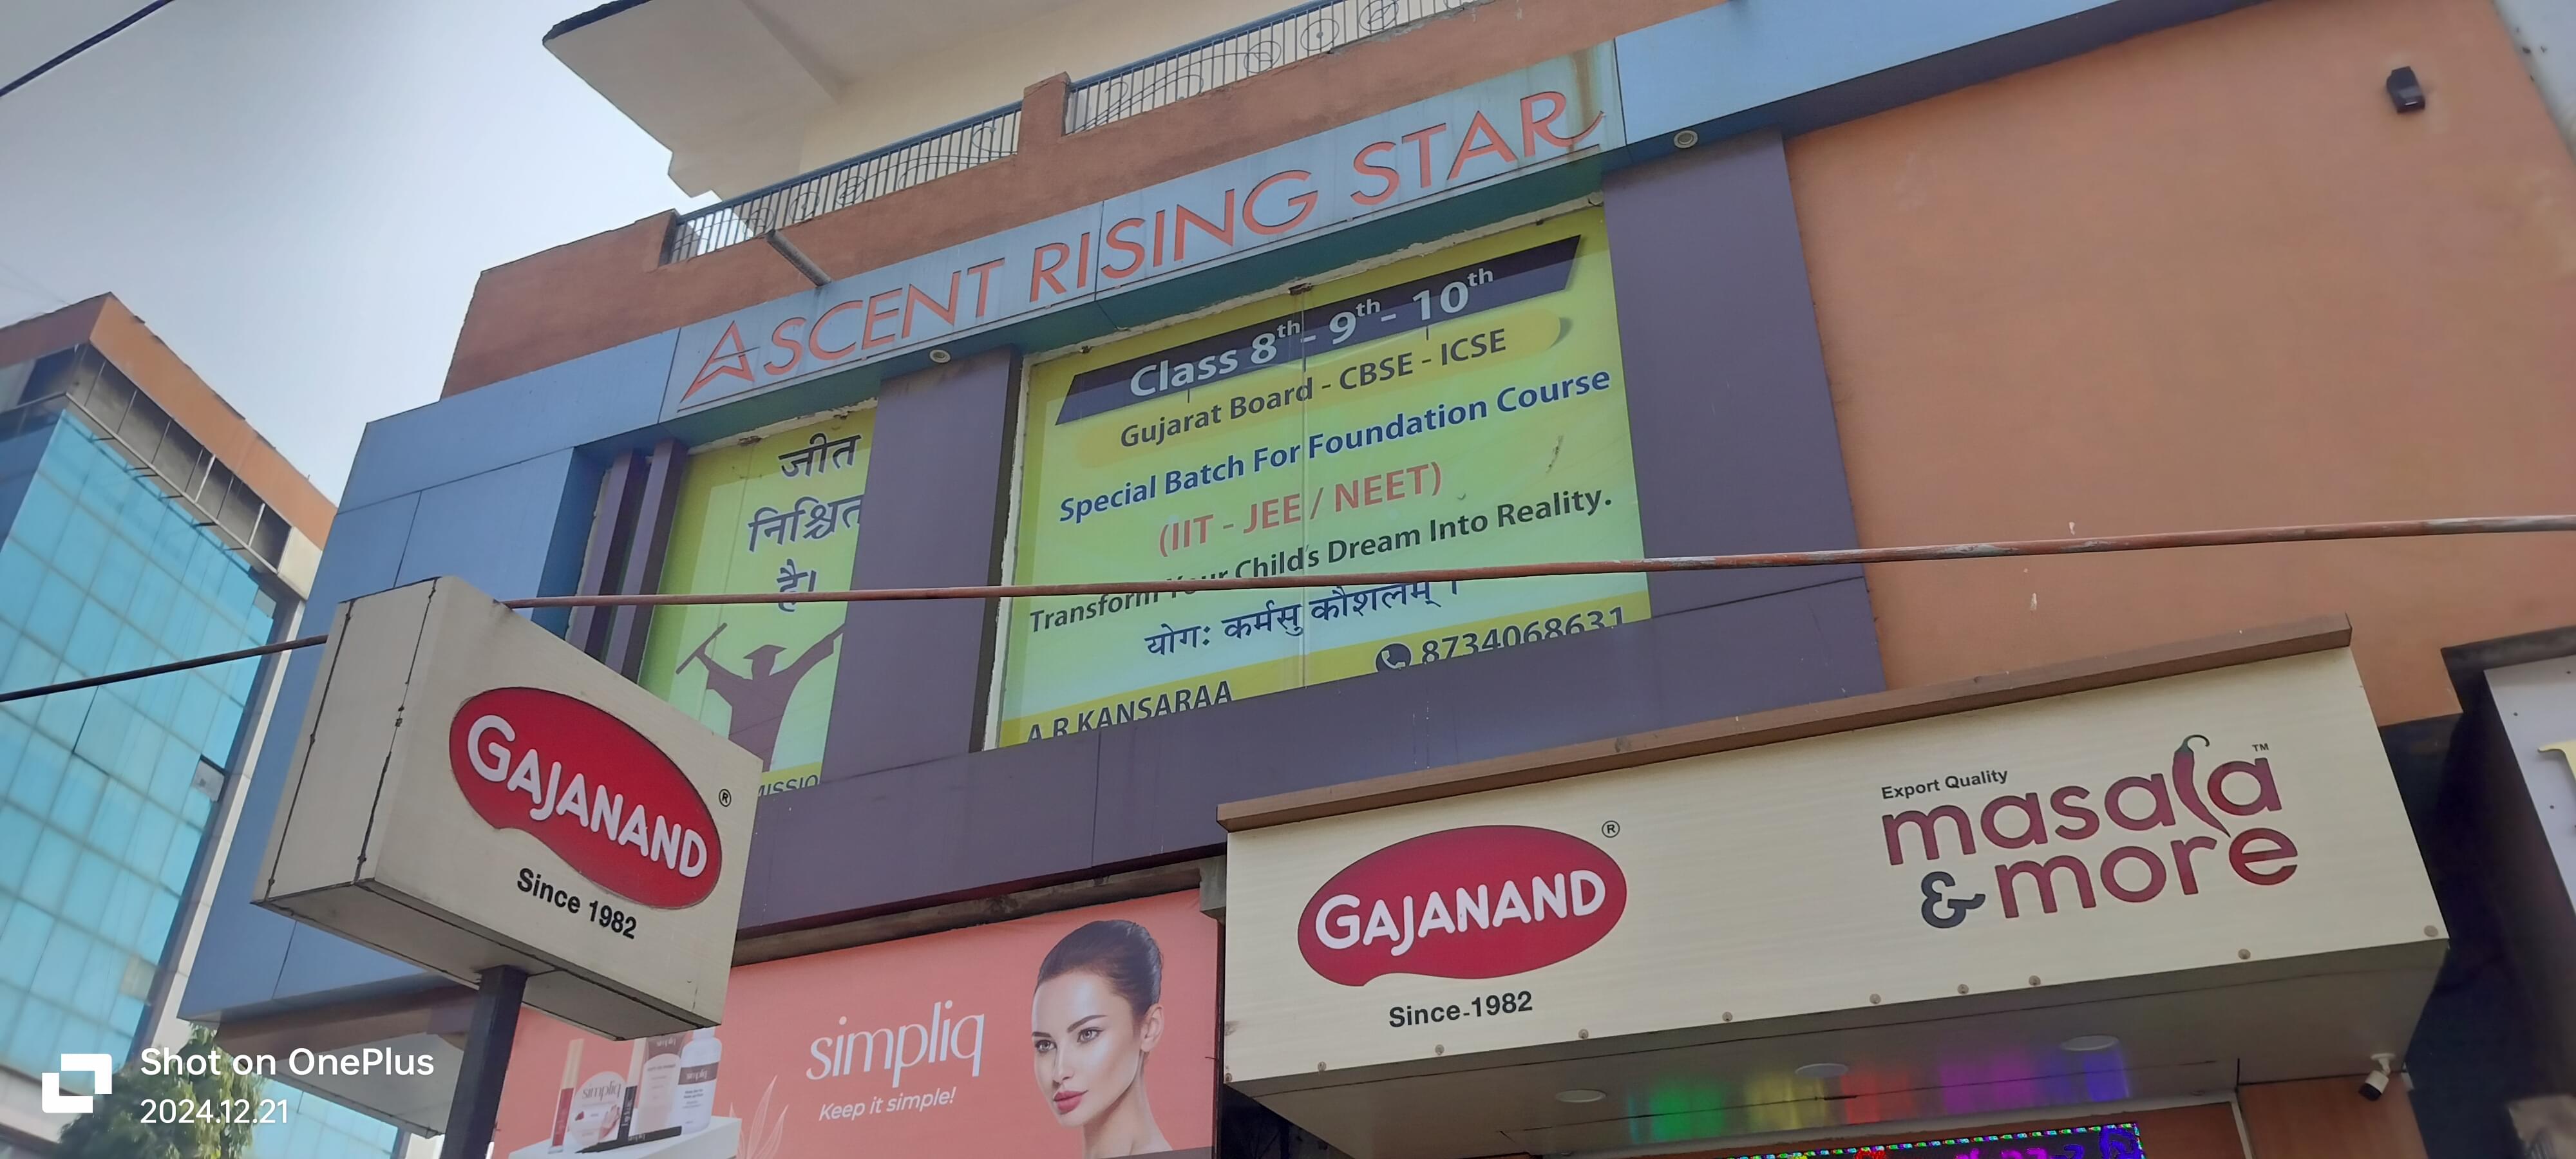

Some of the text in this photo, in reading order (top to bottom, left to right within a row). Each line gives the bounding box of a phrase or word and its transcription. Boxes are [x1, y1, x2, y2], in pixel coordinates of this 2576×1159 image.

[680, 91, 1605, 403] ASCENT RISING STAR
[1130, 349, 1238, 397] Class
[1412, 268, 1493, 321] 10th
[1121, 405, 1222, 448] Gujarat
[1230, 377, 1312, 419] Board
[1340, 352, 1413, 390] CBSE
[1441, 328, 1506, 365] ICSE
[779, 433, 862, 477] जीत
[1059, 371, 1610, 523] Special Batch For Foundation Course
[1159, 514, 1214, 557] (IIT
[1243, 493, 1301, 534] JEE
[1336, 462, 1442, 512] NEET)
[1030, 592, 1159, 632] Transform
[1329, 528, 1421, 563] Dream
[1430, 514, 1488, 542] Into
[1497, 489, 1612, 528] Reality.
[1222, 600, 1303, 639] कर्मसु
[1421, 607, 1623, 663] 8734068631
[1027, 681, 1233, 742] A R KANSARAA
[468, 715, 707, 878] GAJANAND
[1882, 769, 2008, 800] Export Quality
[1882, 735, 2282, 865] masala
[516, 868, 638, 939] Since 1982
[1316, 869, 1606, 956] GAJANAND
[1994, 827, 2298, 918] more
[806, 999, 985, 1088] simpliq
[582, 1080, 621, 1101] simpliq
[818, 1086, 957, 1121] Keep it simple!
